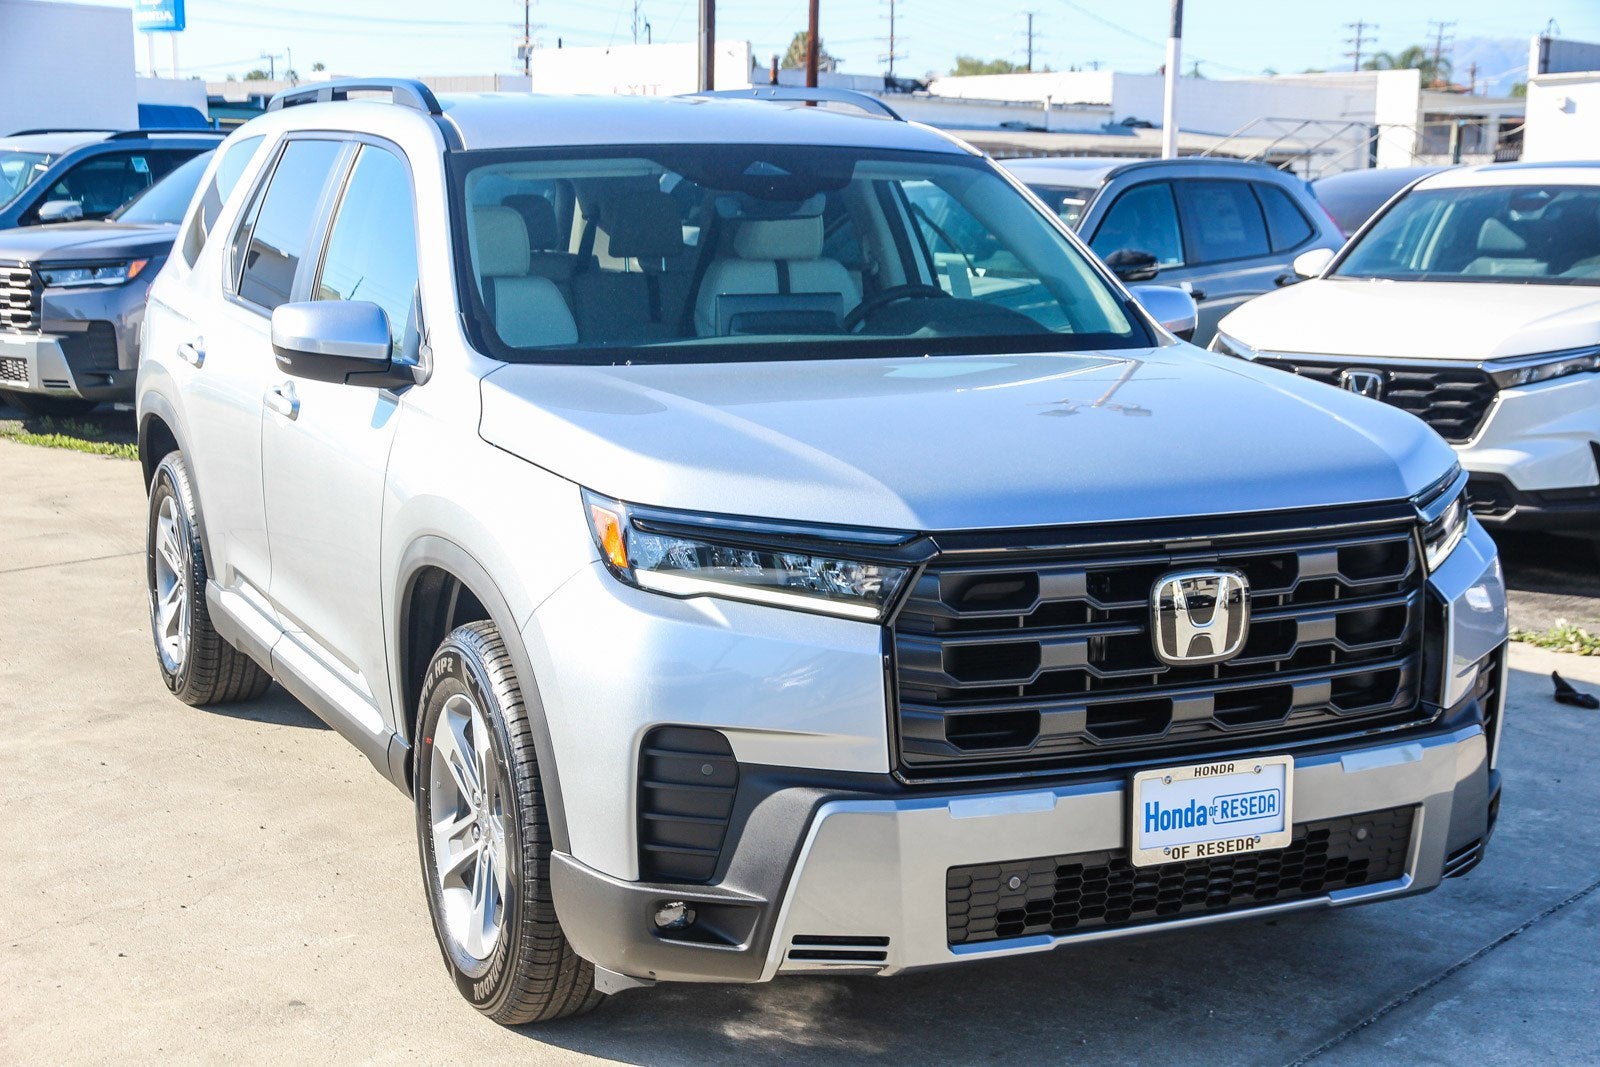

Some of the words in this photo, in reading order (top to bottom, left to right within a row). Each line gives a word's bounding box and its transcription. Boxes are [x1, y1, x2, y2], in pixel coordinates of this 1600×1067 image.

[435, 657, 454, 678] HP2
[1194, 763, 1235, 777] HONDA
[1145, 799, 1208, 833] Honda
[1208, 805, 1219, 817] OF
[1220, 794, 1276, 819] RESEDA
[1171, 845, 1190, 860] OF
[1196, 838, 1254, 857] RESEDA
